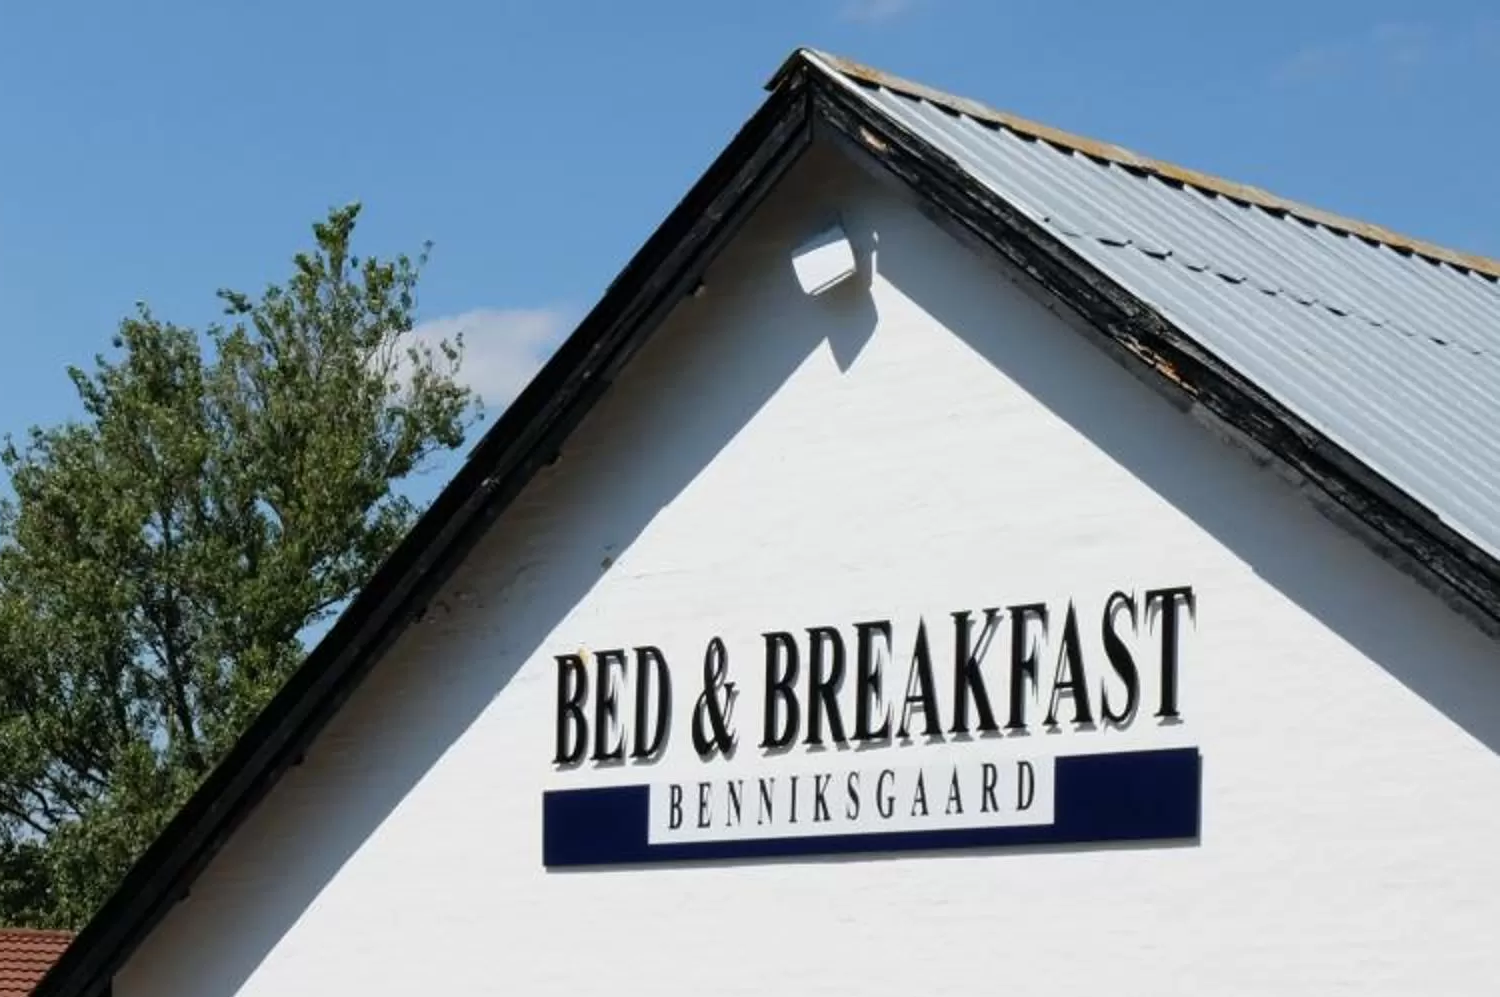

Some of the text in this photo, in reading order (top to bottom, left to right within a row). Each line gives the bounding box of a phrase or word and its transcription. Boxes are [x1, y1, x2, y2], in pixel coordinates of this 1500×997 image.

[552, 585, 1197, 766] BED & BREAKFAST
[668, 760, 1035, 830] BENNIKSGAARD
